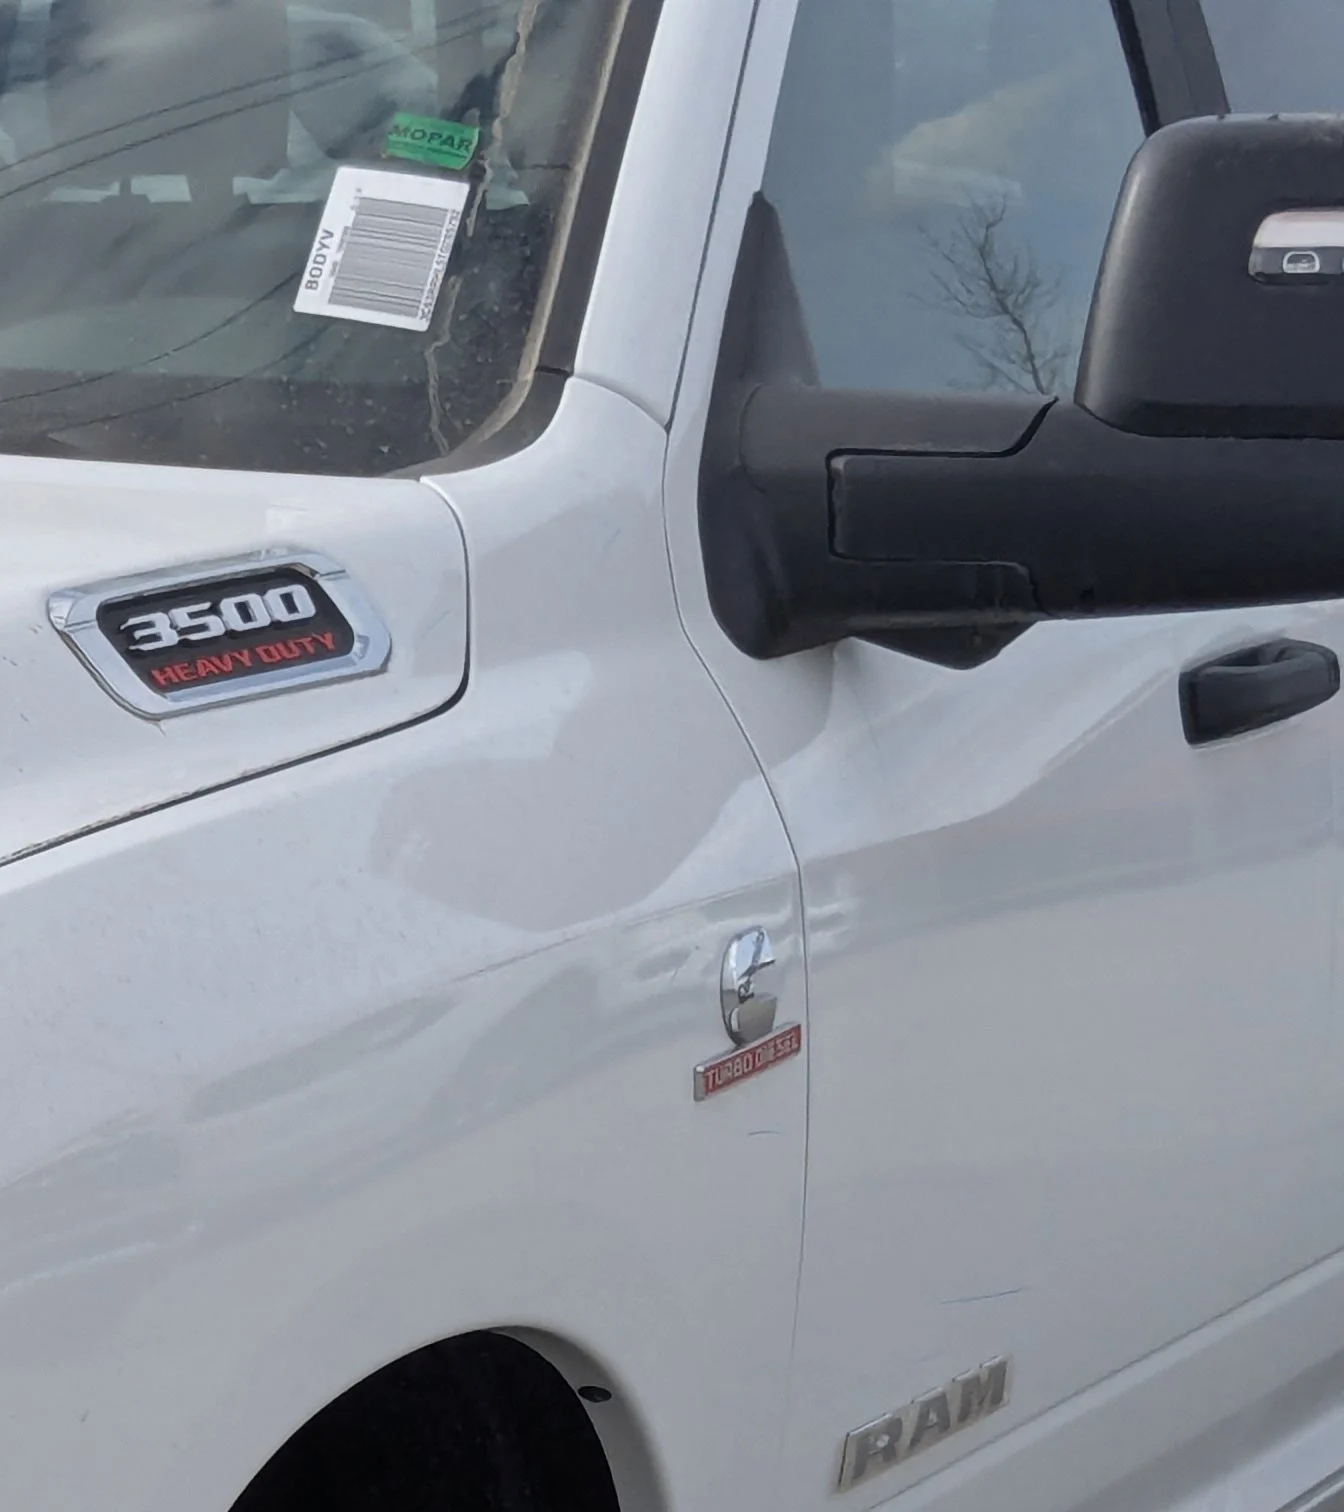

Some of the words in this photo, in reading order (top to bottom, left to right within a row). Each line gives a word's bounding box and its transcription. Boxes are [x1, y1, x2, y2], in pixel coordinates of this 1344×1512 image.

[388, 124, 473, 154] MOPAR
[305, 229, 334, 290] BODYV
[120, 584, 316, 651] 3500
[150, 651, 253, 688] HEAVY
[256, 631, 336, 664] DUTY
[706, 1056, 754, 1093] TURBO
[838, 1355, 1011, 1491] RAM
